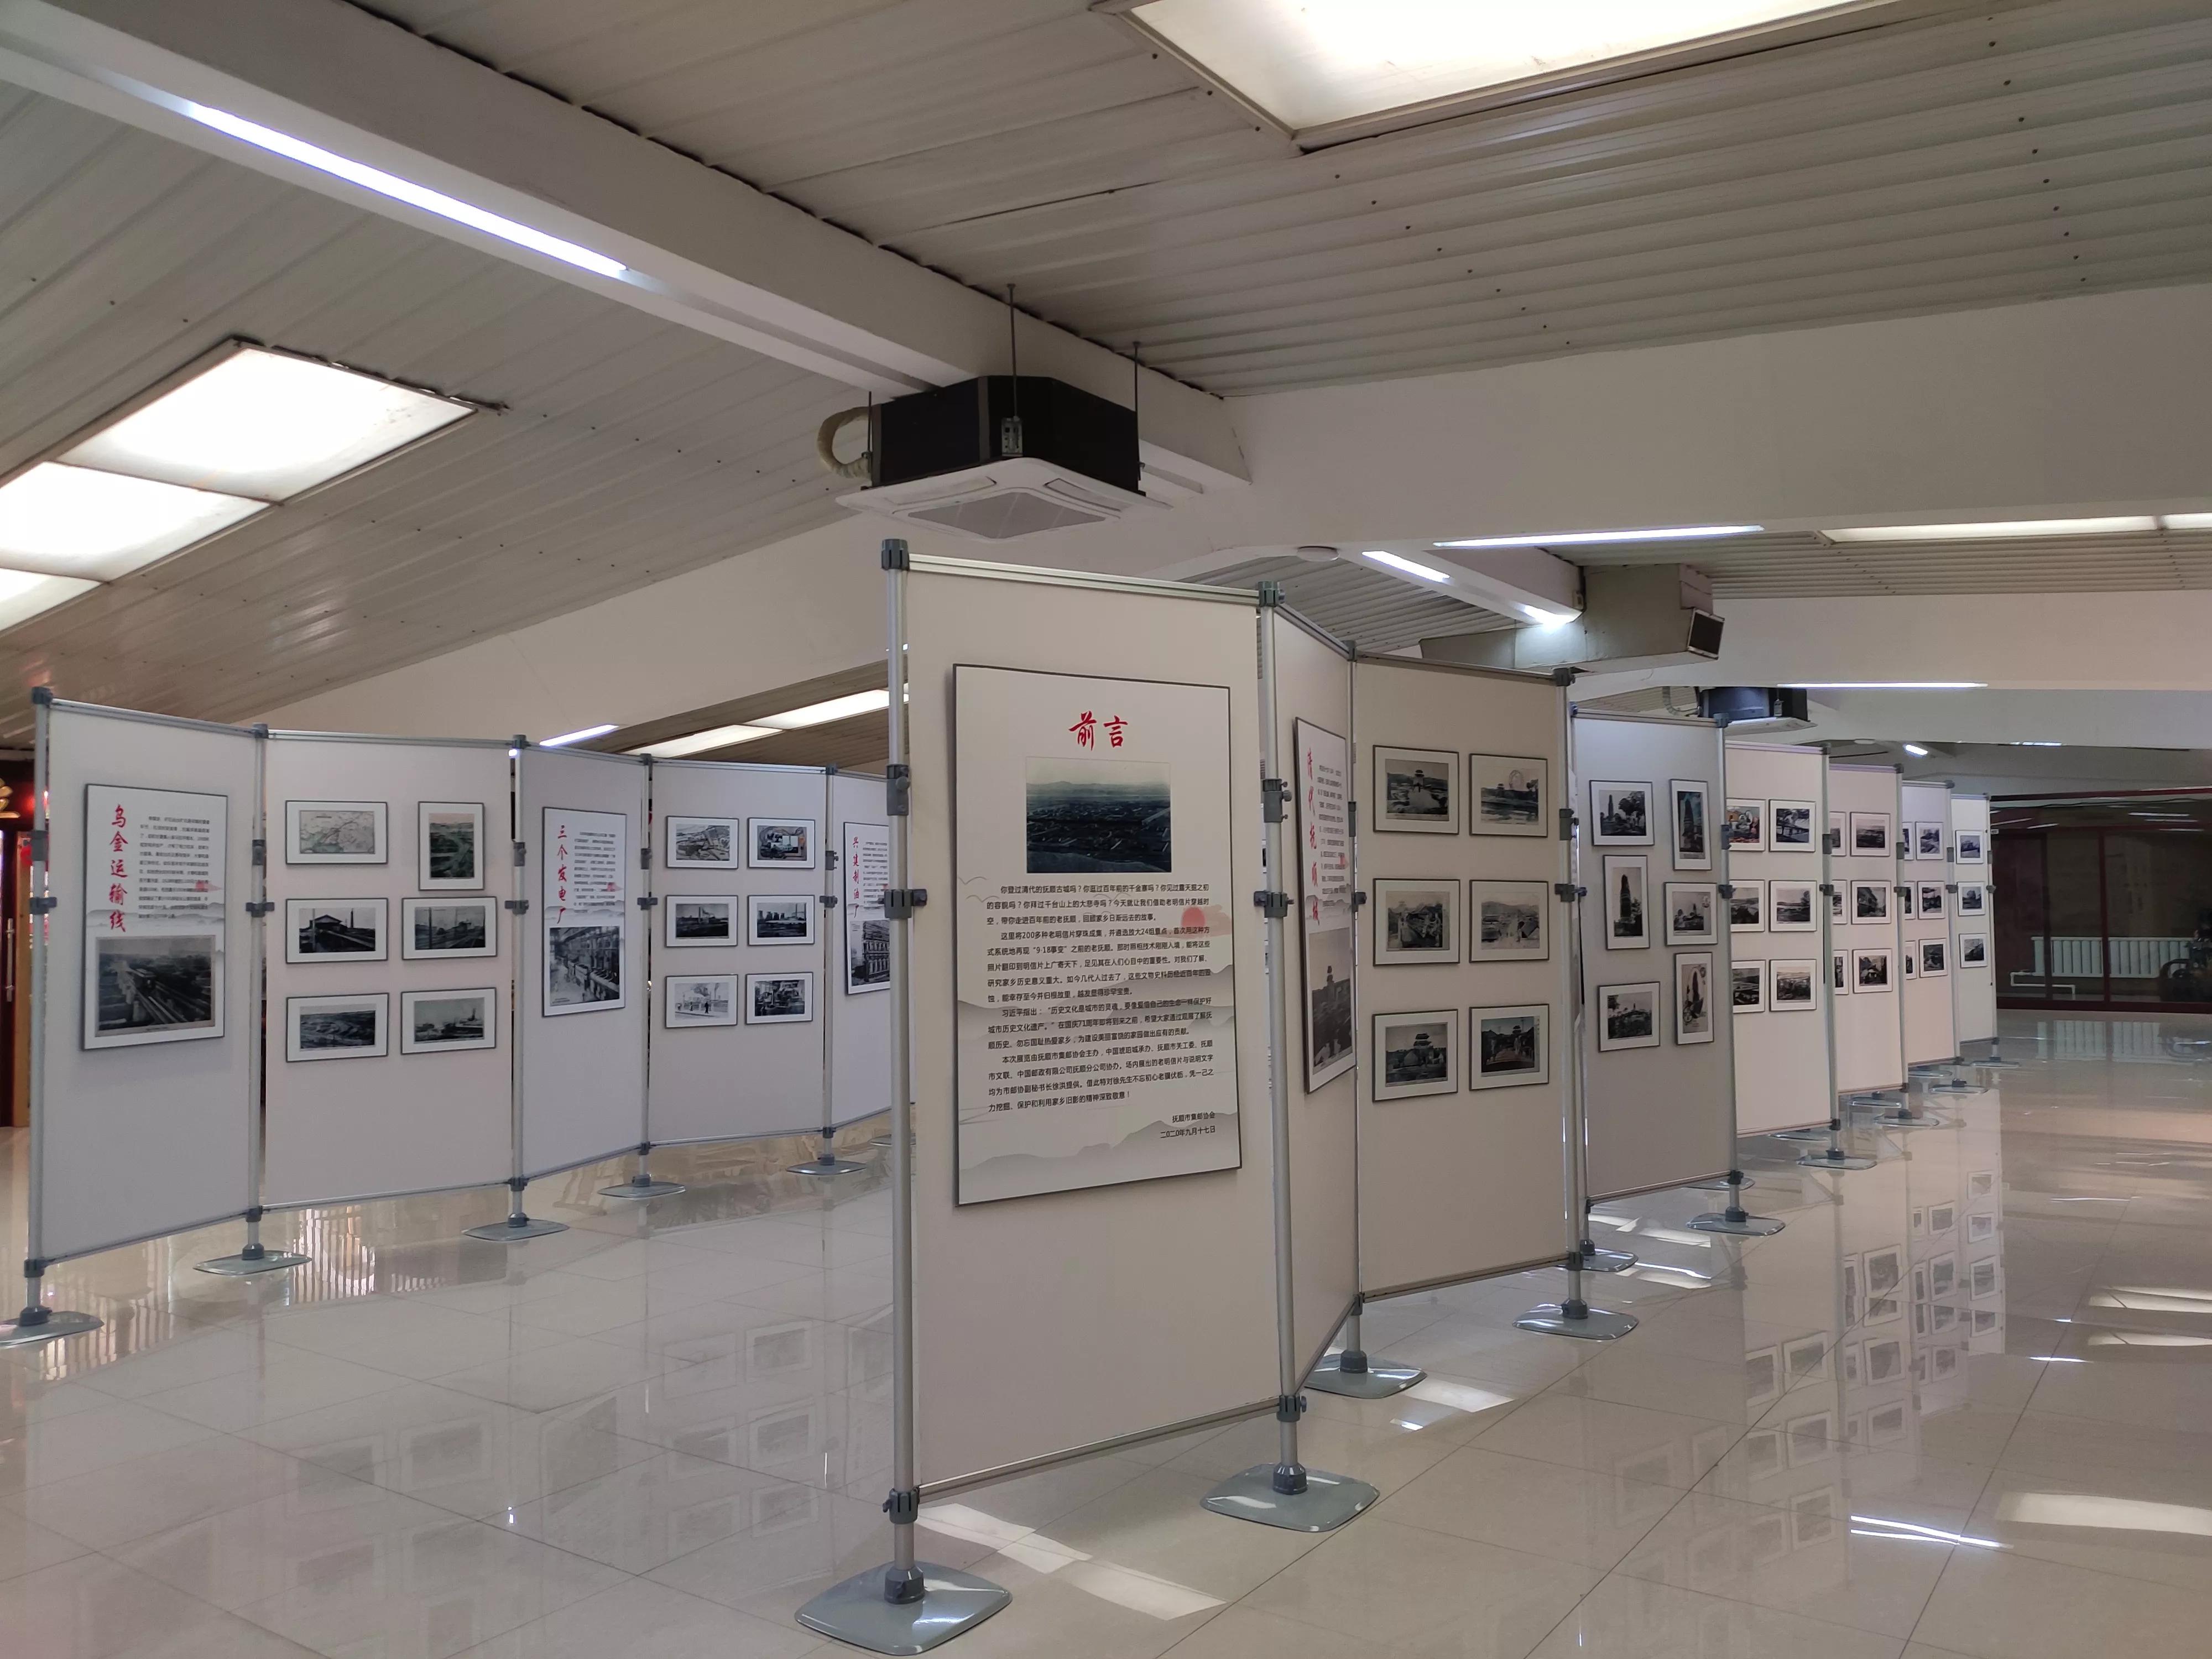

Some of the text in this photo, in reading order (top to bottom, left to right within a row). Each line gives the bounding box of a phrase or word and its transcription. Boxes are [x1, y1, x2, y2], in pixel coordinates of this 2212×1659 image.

[1068, 711, 1128, 751] 前言
[109, 804, 128, 932] 乌金运输线
[557, 825, 568, 924] 三个发电厂
